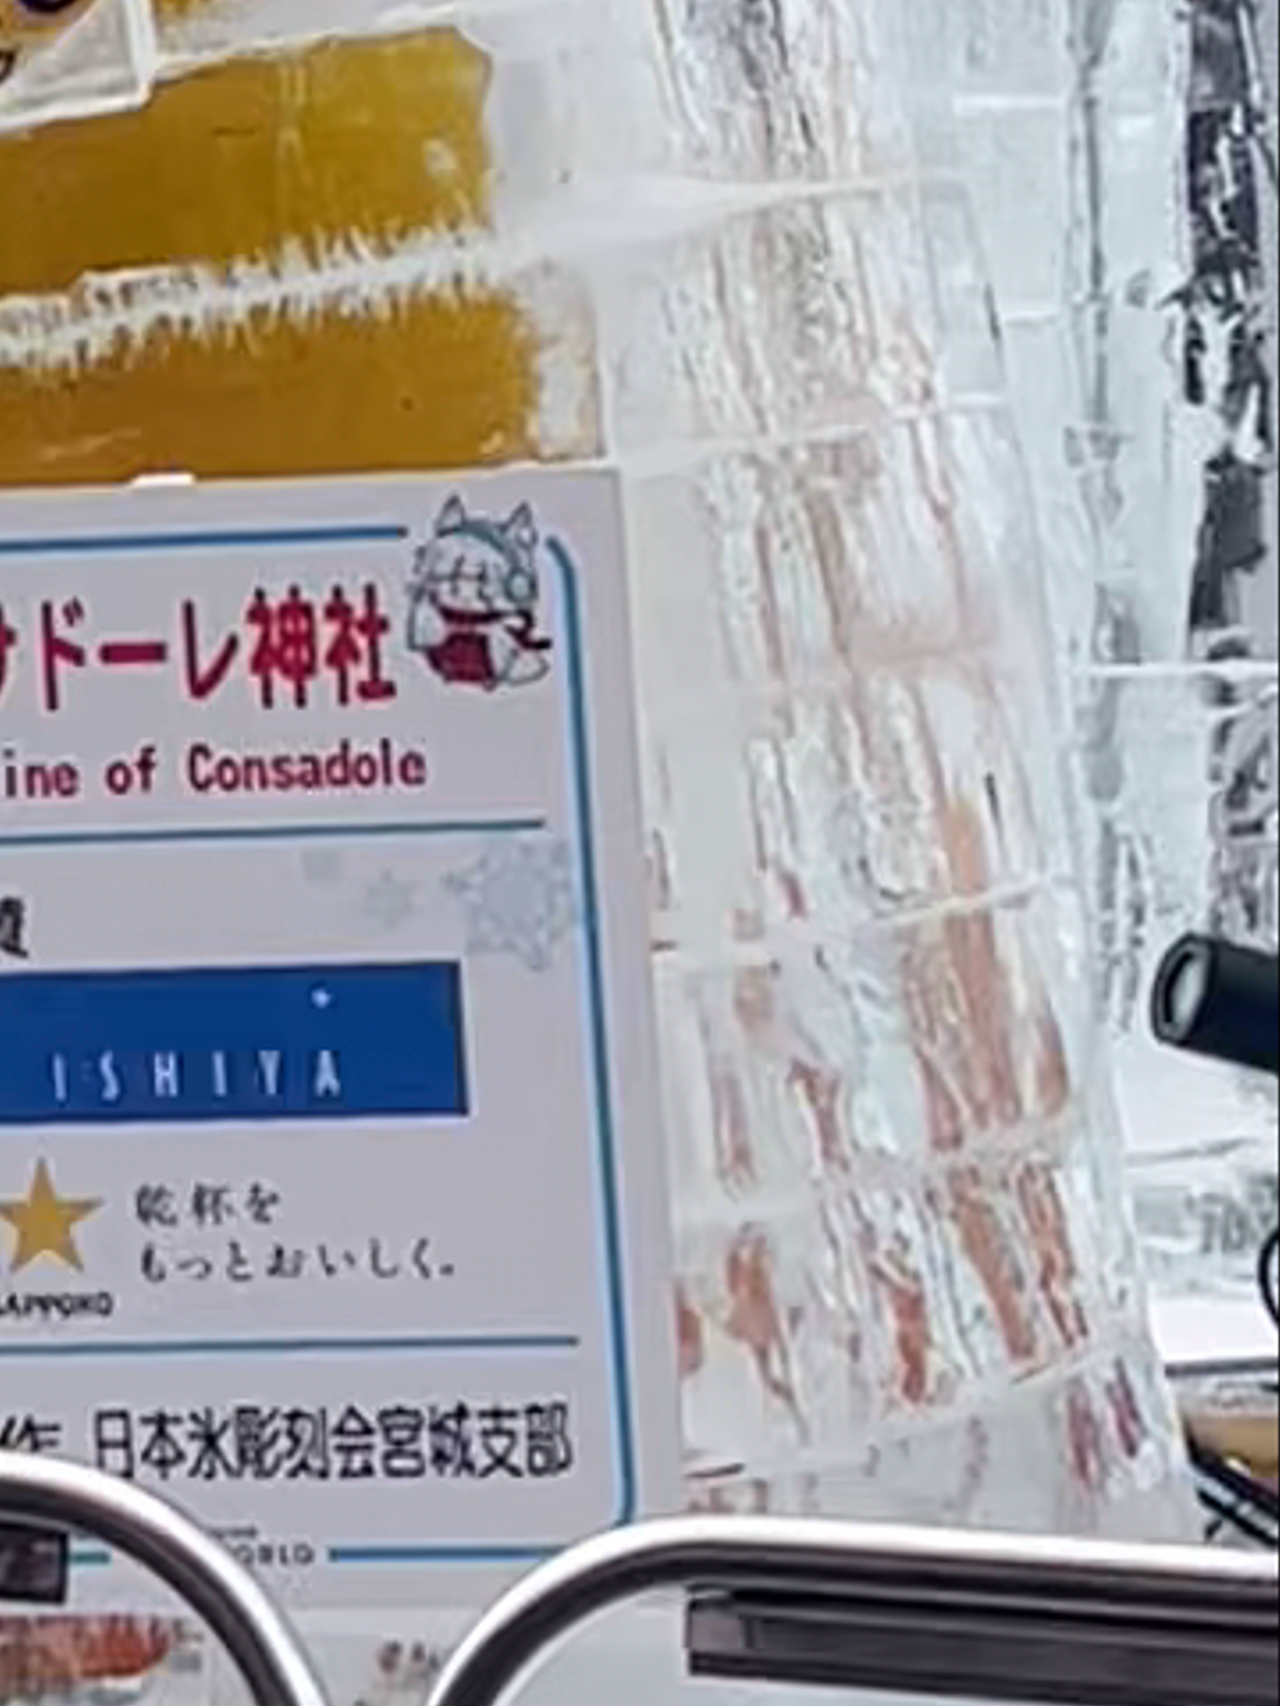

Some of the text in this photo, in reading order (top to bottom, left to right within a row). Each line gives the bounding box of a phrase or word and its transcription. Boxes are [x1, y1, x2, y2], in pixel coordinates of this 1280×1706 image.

[104, 743, 156, 793] of
[186, 736, 427, 792] Consadole
[52, 1049, 342, 1102] ISHIYA
[136, 1183, 280, 1227] 乾杯を
[92, 1401, 575, 1481] 日本氷彫刻会宮城支部
